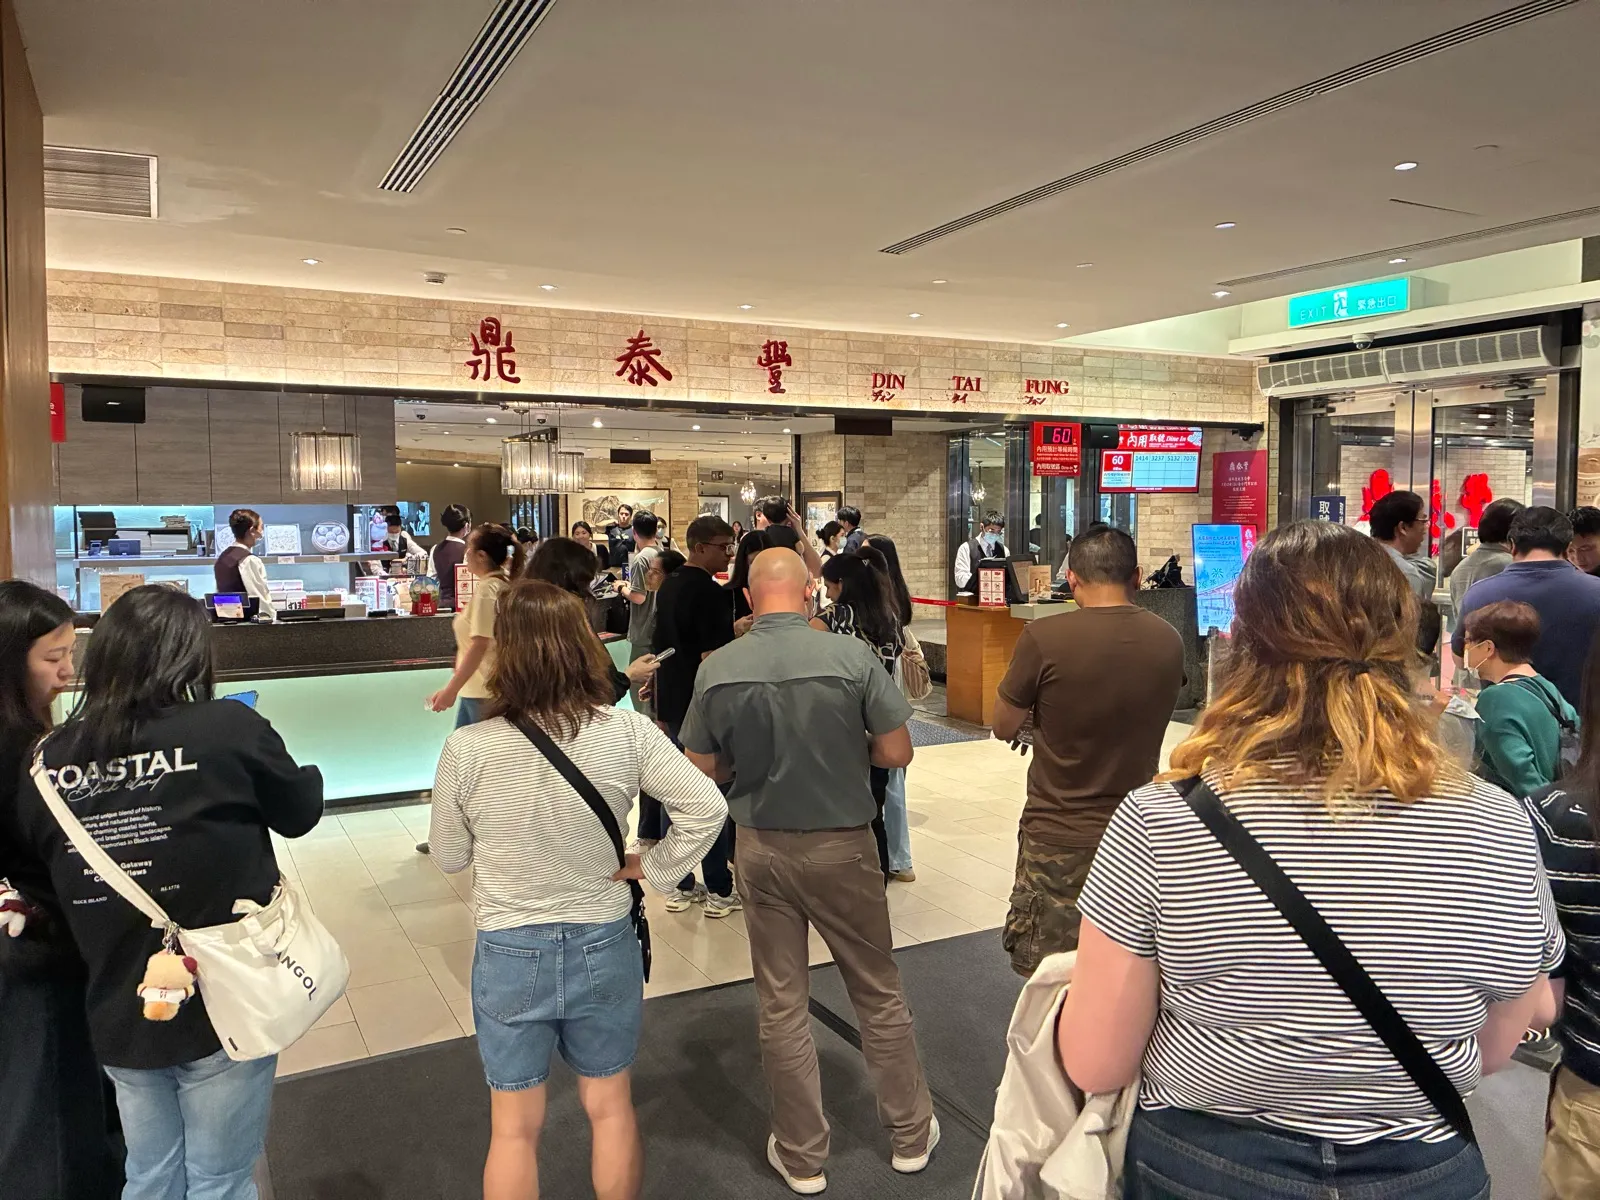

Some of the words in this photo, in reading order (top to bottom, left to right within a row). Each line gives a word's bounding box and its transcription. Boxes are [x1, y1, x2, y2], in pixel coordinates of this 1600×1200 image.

[1357, 295, 1397, 311] 緊急出口
[1300, 305, 1327, 320] EXIT
[871, 372, 906, 390] DIN
[952, 375, 982, 392] TAI
[1024, 378, 1069, 395] FUNG
[1052, 427, 1071, 443] 60
[1112, 455, 1124, 465] 60
[120, 859, 152, 869] Getaway
